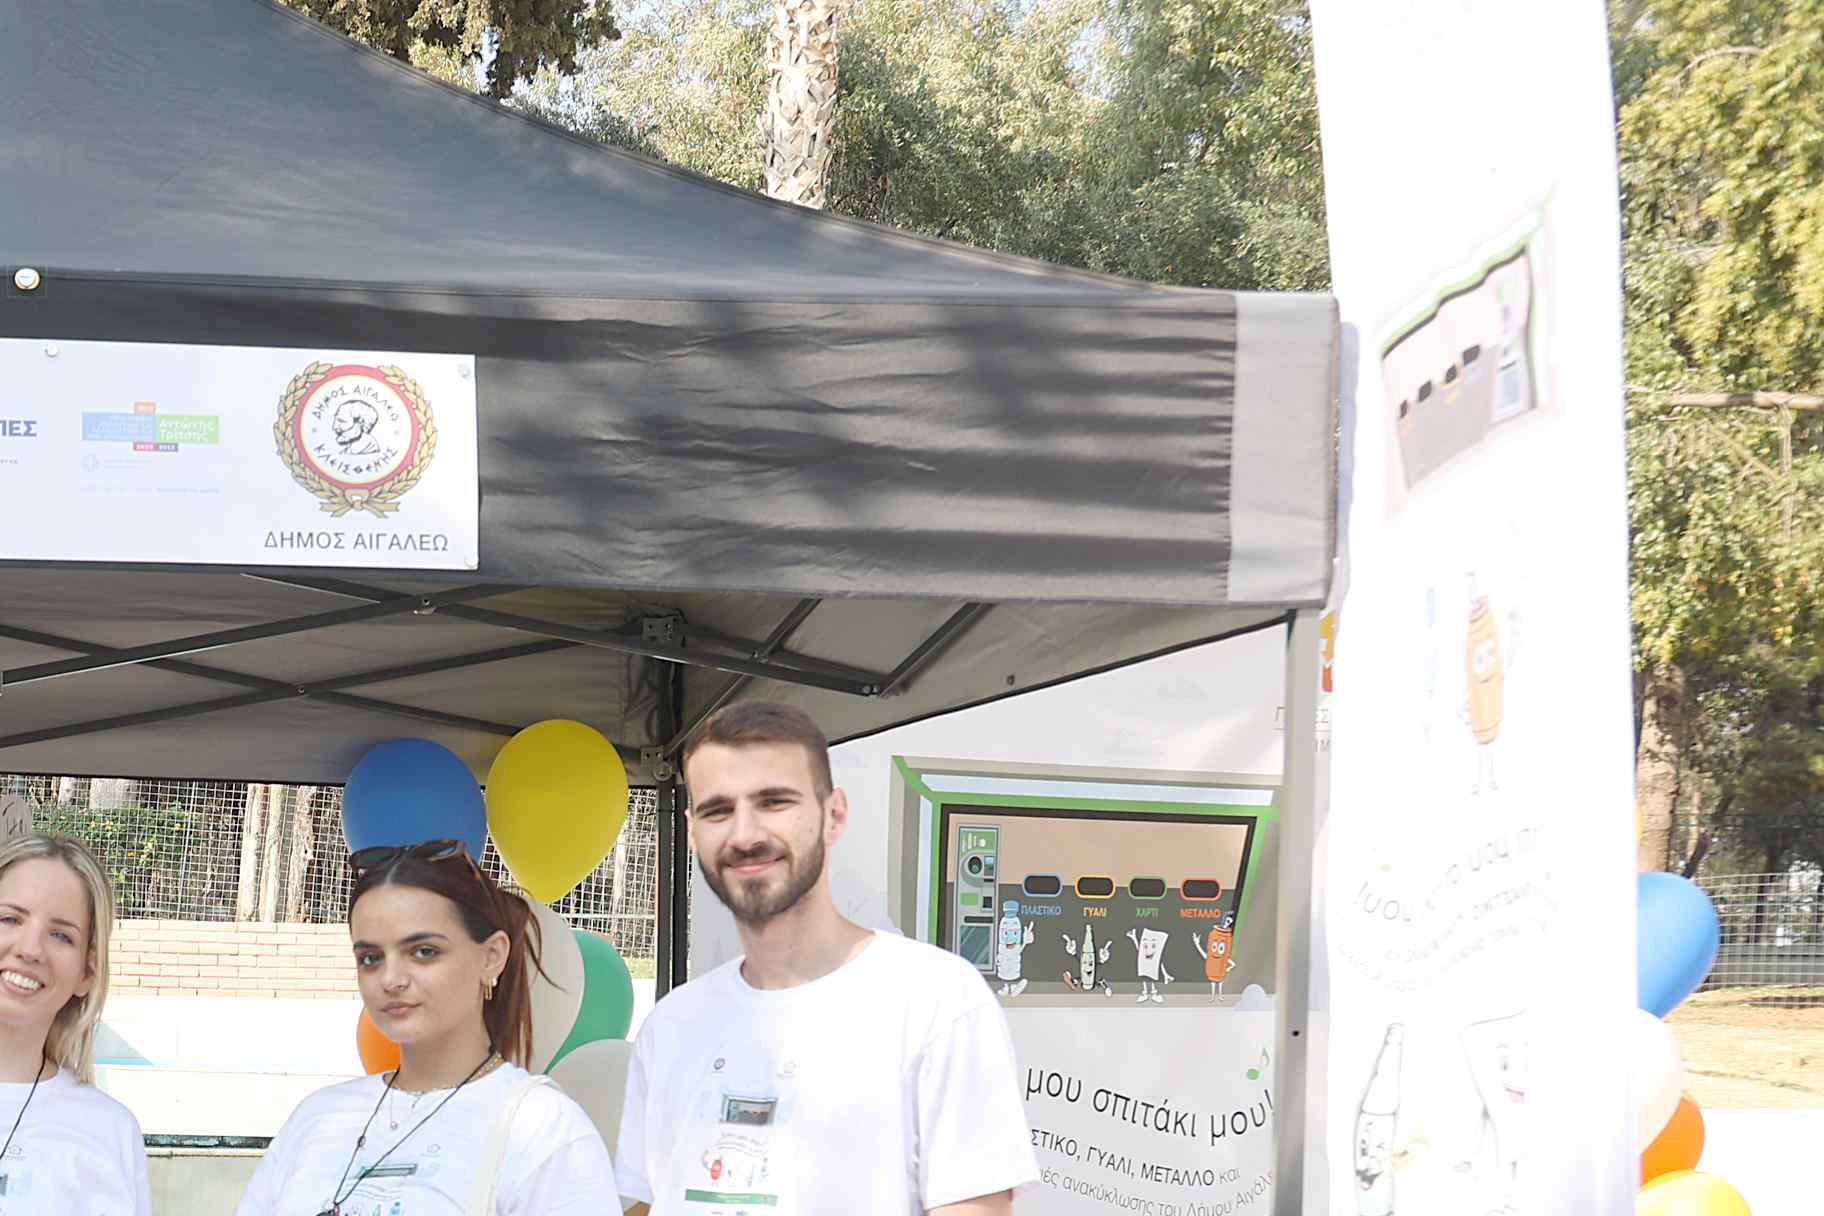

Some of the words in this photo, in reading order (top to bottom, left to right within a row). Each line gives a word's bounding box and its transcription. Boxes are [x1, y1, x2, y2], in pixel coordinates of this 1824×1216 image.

[264, 531, 346, 550] ΔΗΜΟΣ
[352, 532, 449, 552] ΑΙΓΑΛΕΩ
[1020, 905, 1063, 917] ΠΛΑΣΤΙΚΟ
[1082, 906, 1108, 918] ΓΥΑΛΙ
[1135, 907, 1159, 918] ΧΑΡΤΙ
[1179, 907, 1222, 919] ΜΕΤΑΛΛΟ
[1026, 1067, 1082, 1104] μου
[1092, 1087, 1197, 1138] σπιτάκι
[1210, 1089, 1275, 1147] μου!
[1030, 1128, 1081, 1162] ΣΤΙΚΟ,
[1086, 1145, 1135, 1179] ΓΥΑΛΙ,
[1140, 1161, 1216, 1187] ΜΕΤΑΛΛΟ
[1217, 1167, 1241, 1185] και
[1062, 1172, 1154, 1216] ανακύκλωσης
